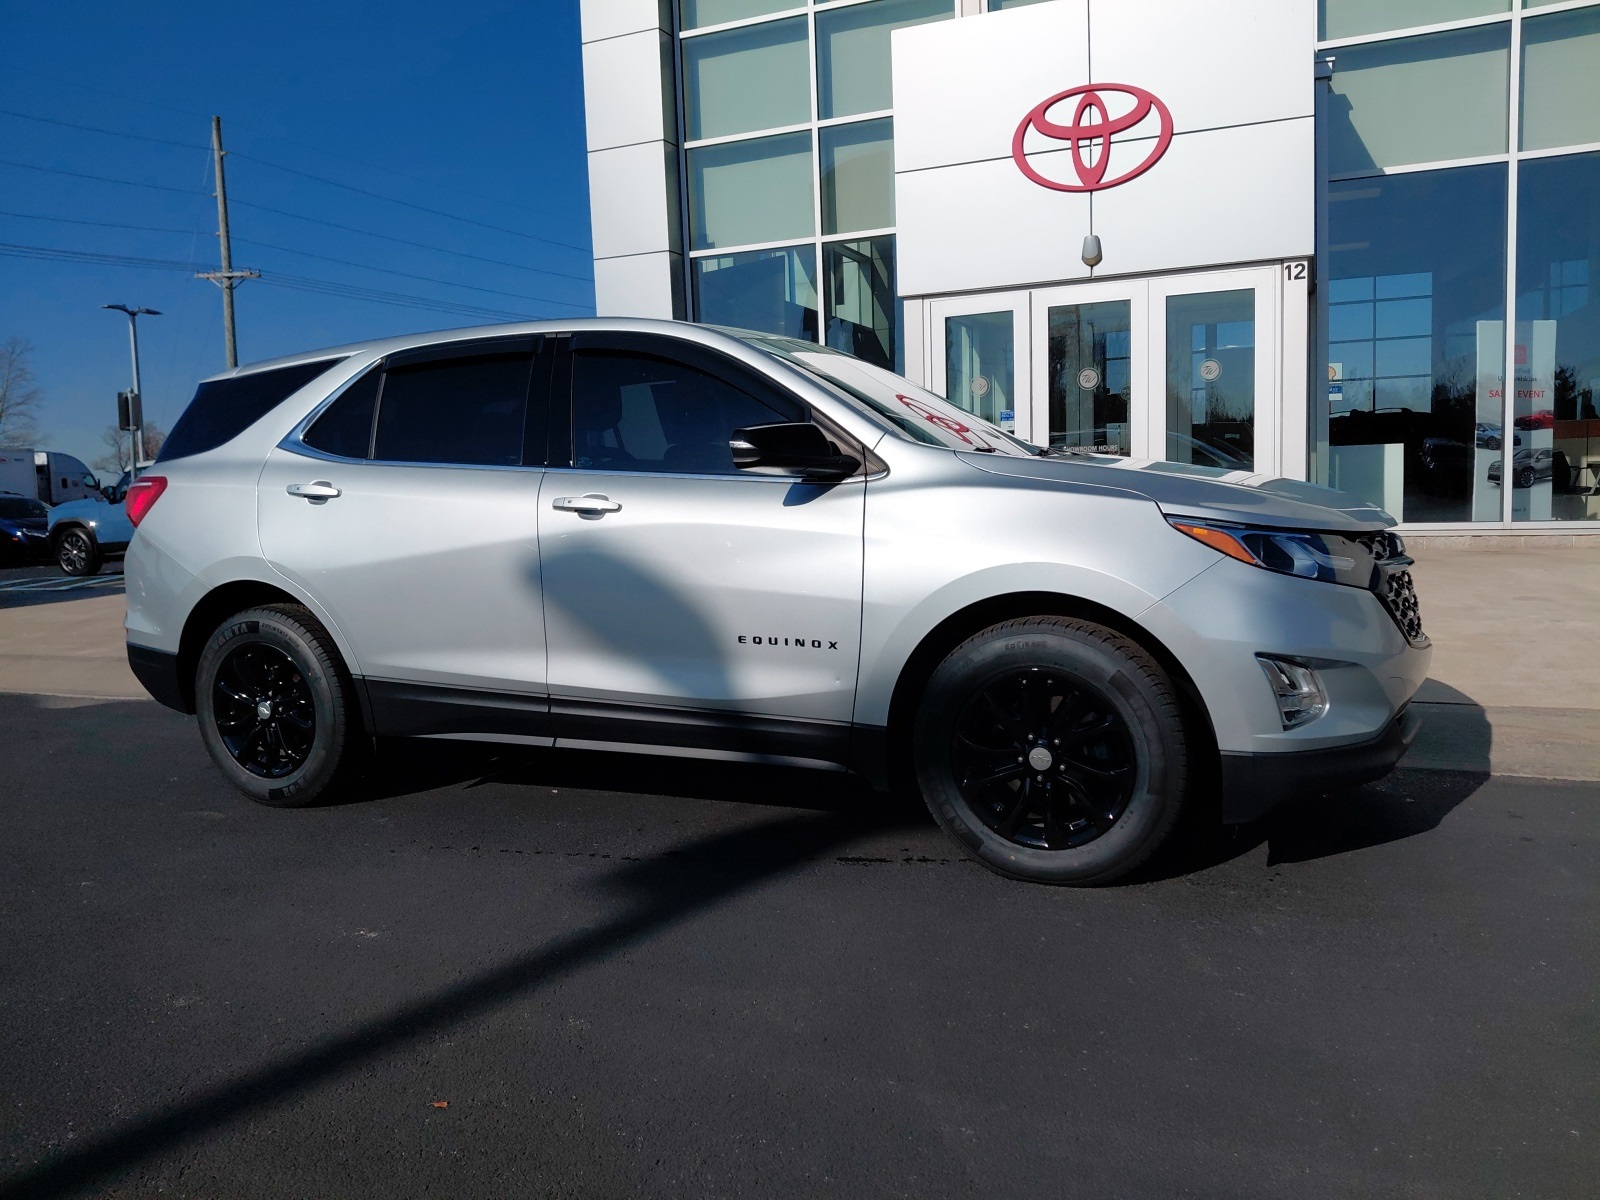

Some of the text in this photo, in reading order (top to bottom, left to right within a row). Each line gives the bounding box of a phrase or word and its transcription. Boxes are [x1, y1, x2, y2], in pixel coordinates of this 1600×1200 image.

[1284, 262, 1306, 281] 12
[1517, 390, 1545, 398] EVENT
[1098, 444, 1118, 452] HOURS
[738, 635, 838, 650] EQUINOX
